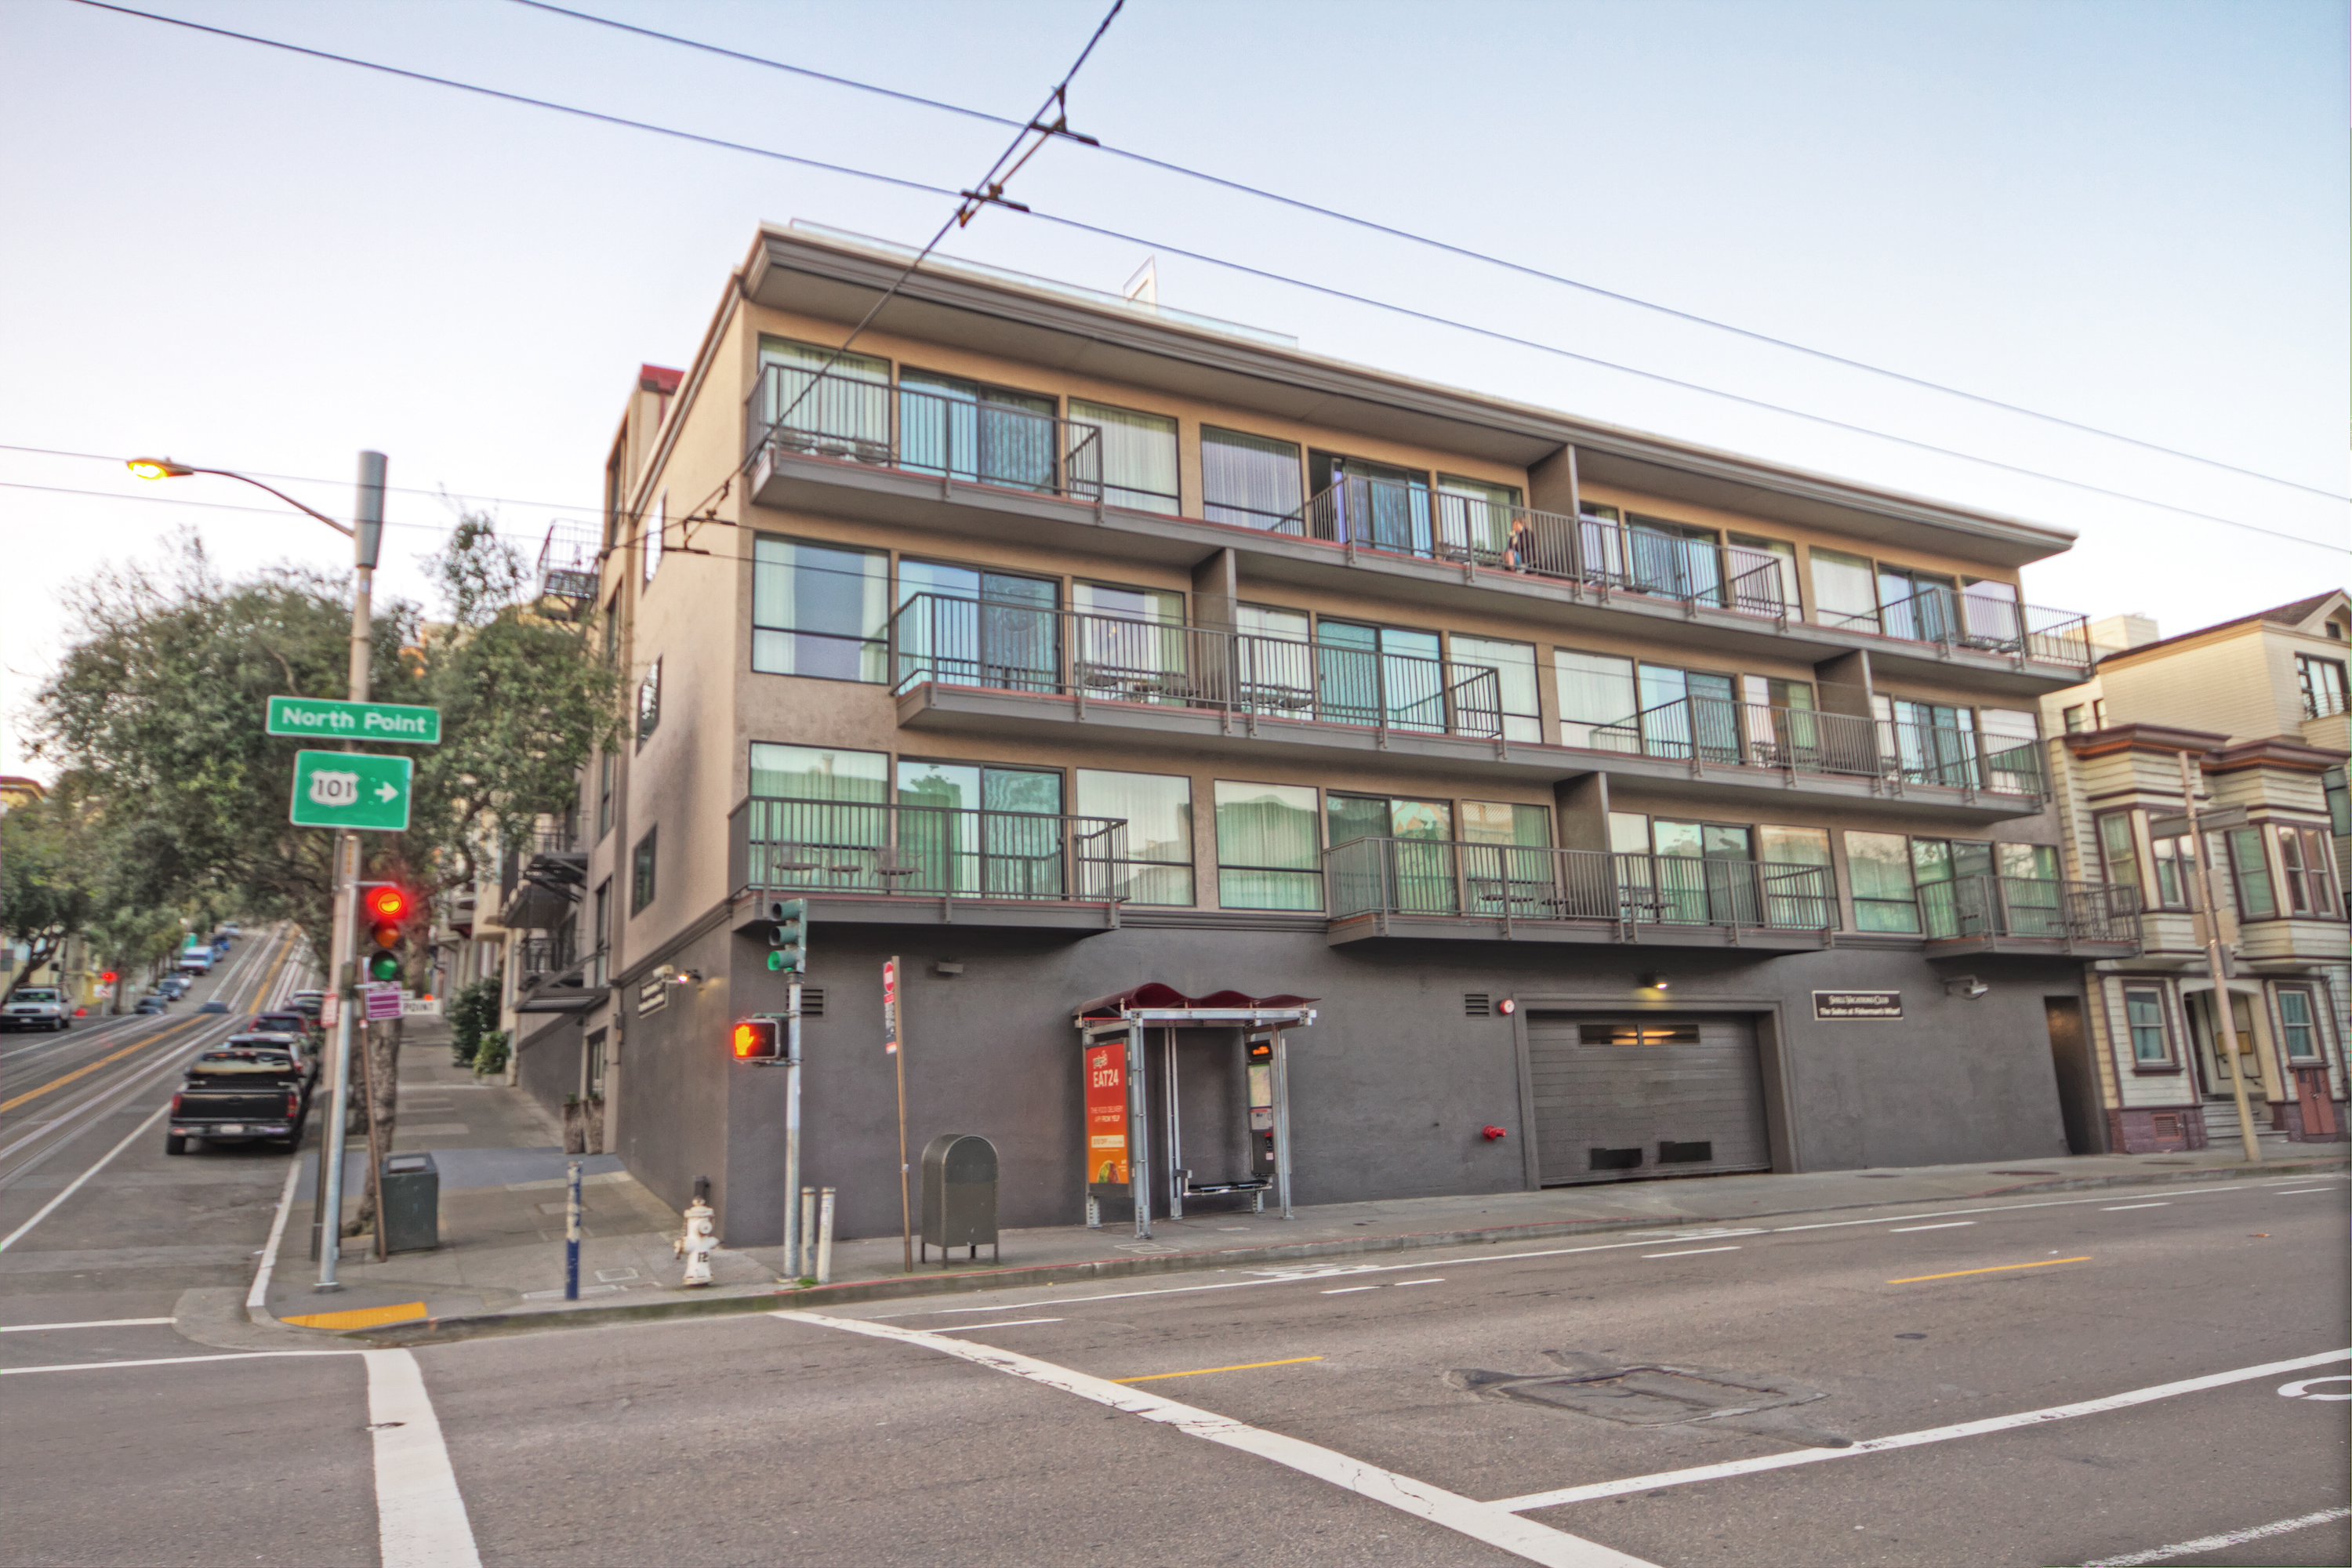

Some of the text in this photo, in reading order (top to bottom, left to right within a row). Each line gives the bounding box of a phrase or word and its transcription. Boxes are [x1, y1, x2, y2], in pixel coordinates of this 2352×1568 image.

[281, 706, 426, 733] North Point
[317, 779, 352, 797] 101
[1093, 1069, 1120, 1088] EAT24
